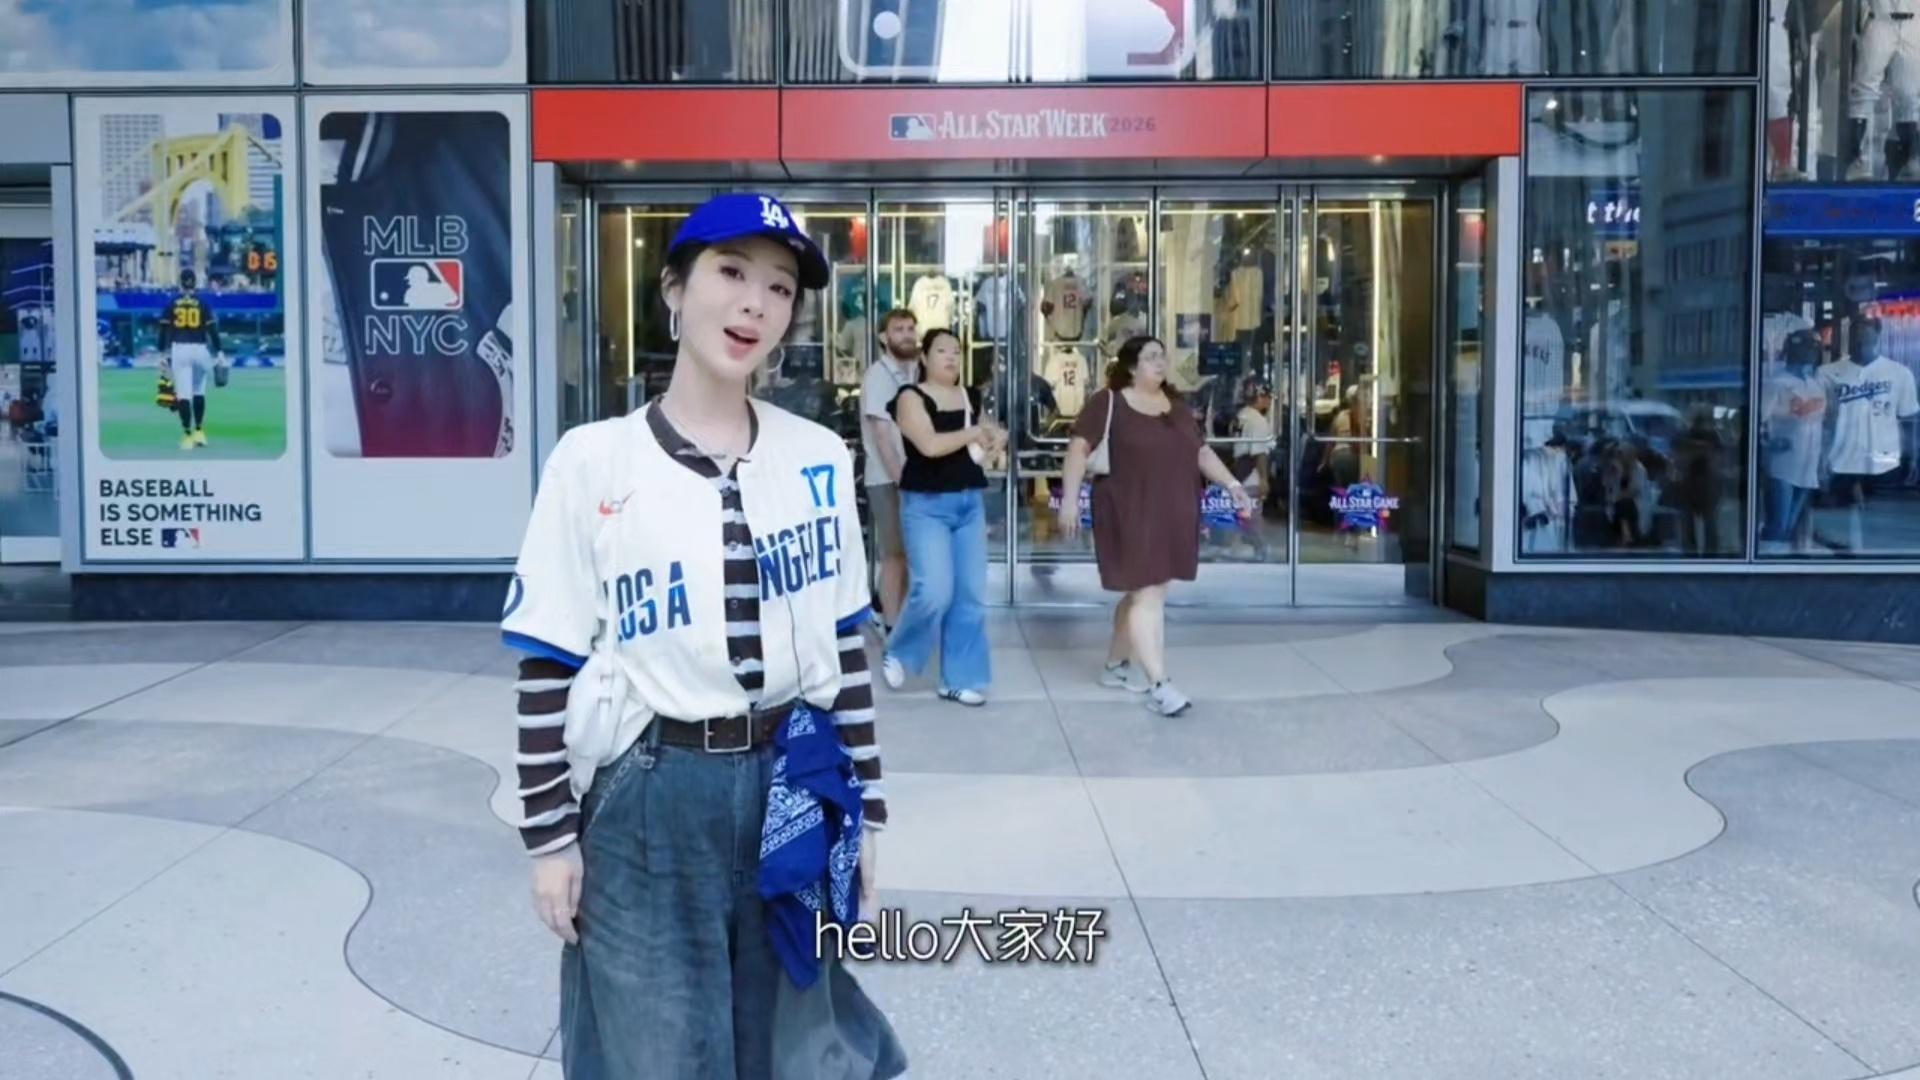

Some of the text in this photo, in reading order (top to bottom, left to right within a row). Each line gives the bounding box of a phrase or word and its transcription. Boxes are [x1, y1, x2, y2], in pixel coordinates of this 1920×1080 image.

[939, 109, 1157, 139] ALL STAR WEEK 2026
[759, 196, 790, 230] LA
[363, 215, 469, 256] MLB
[1063, 294, 1077, 310] 12
[173, 307, 201, 328] 30
[364, 315, 469, 356] NYC
[1063, 370, 1076, 386] 12
[99, 479, 215, 498] BASEBALL
[801, 464, 836, 508] 17
[100, 504, 262, 522] IS SOMETHING
[101, 528, 153, 546] ELSE
